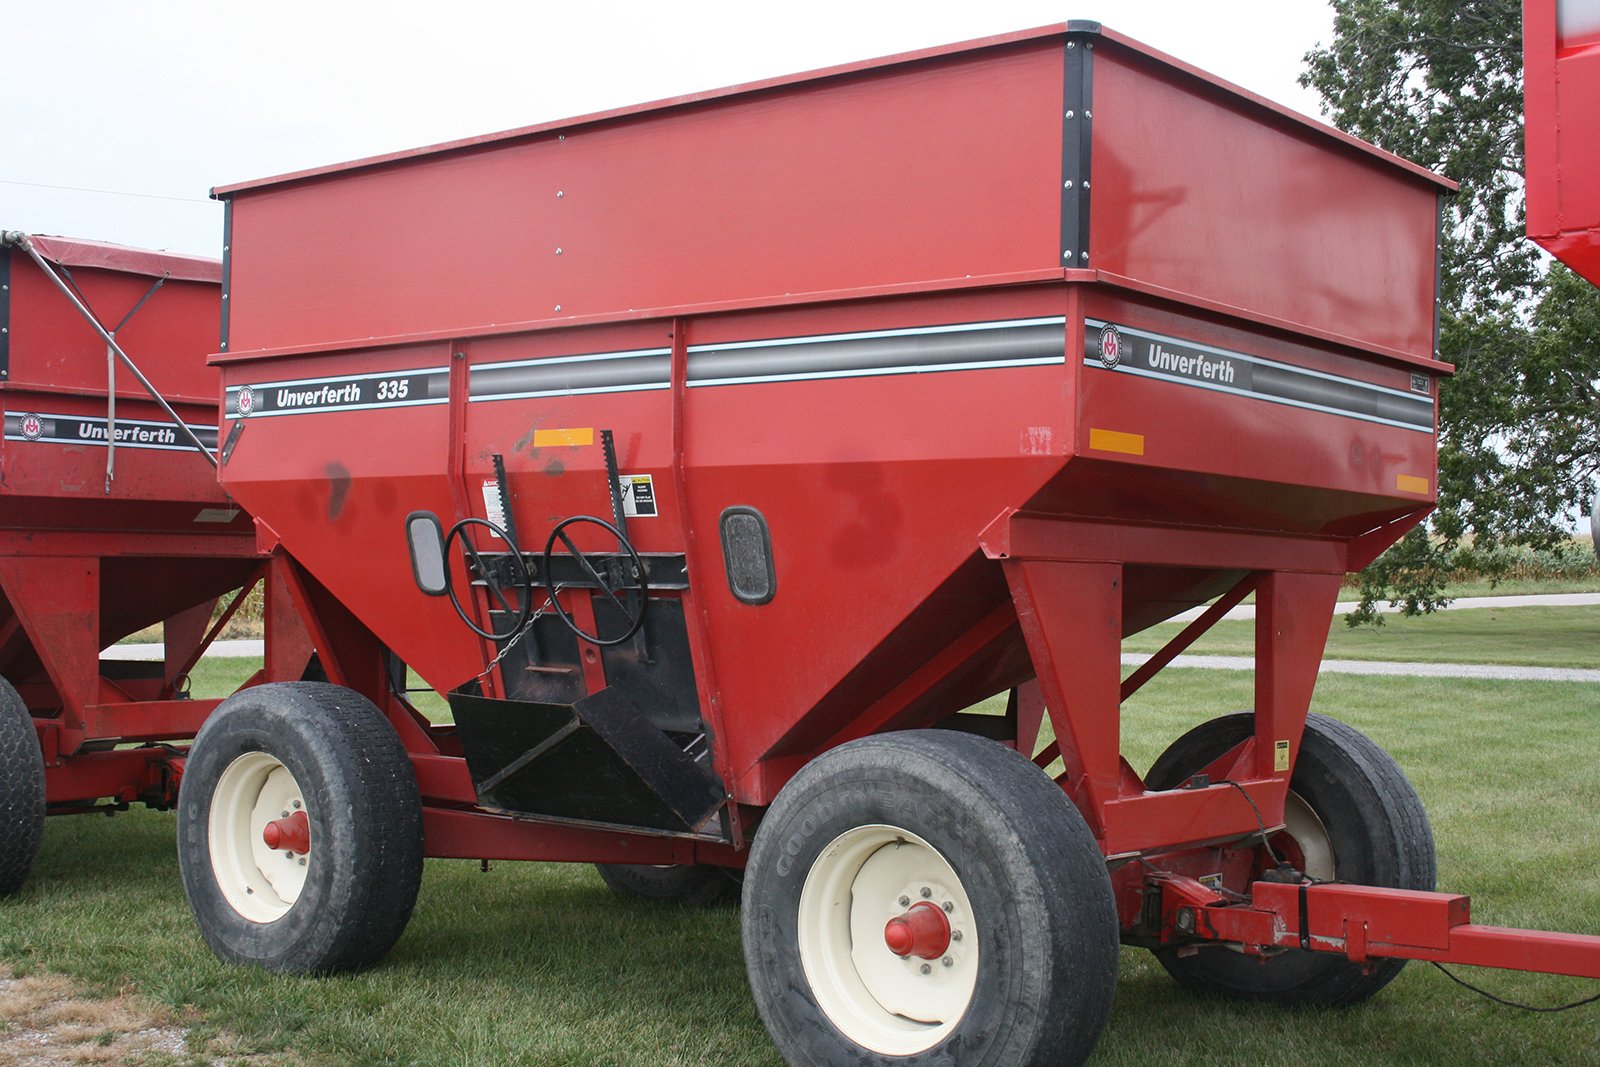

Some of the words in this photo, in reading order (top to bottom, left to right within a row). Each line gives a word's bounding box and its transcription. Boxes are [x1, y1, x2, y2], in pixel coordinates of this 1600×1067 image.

[1148, 344, 1235, 383] Unverferth
[276, 383, 360, 408] Unverferth
[376, 379, 409, 400] 335
